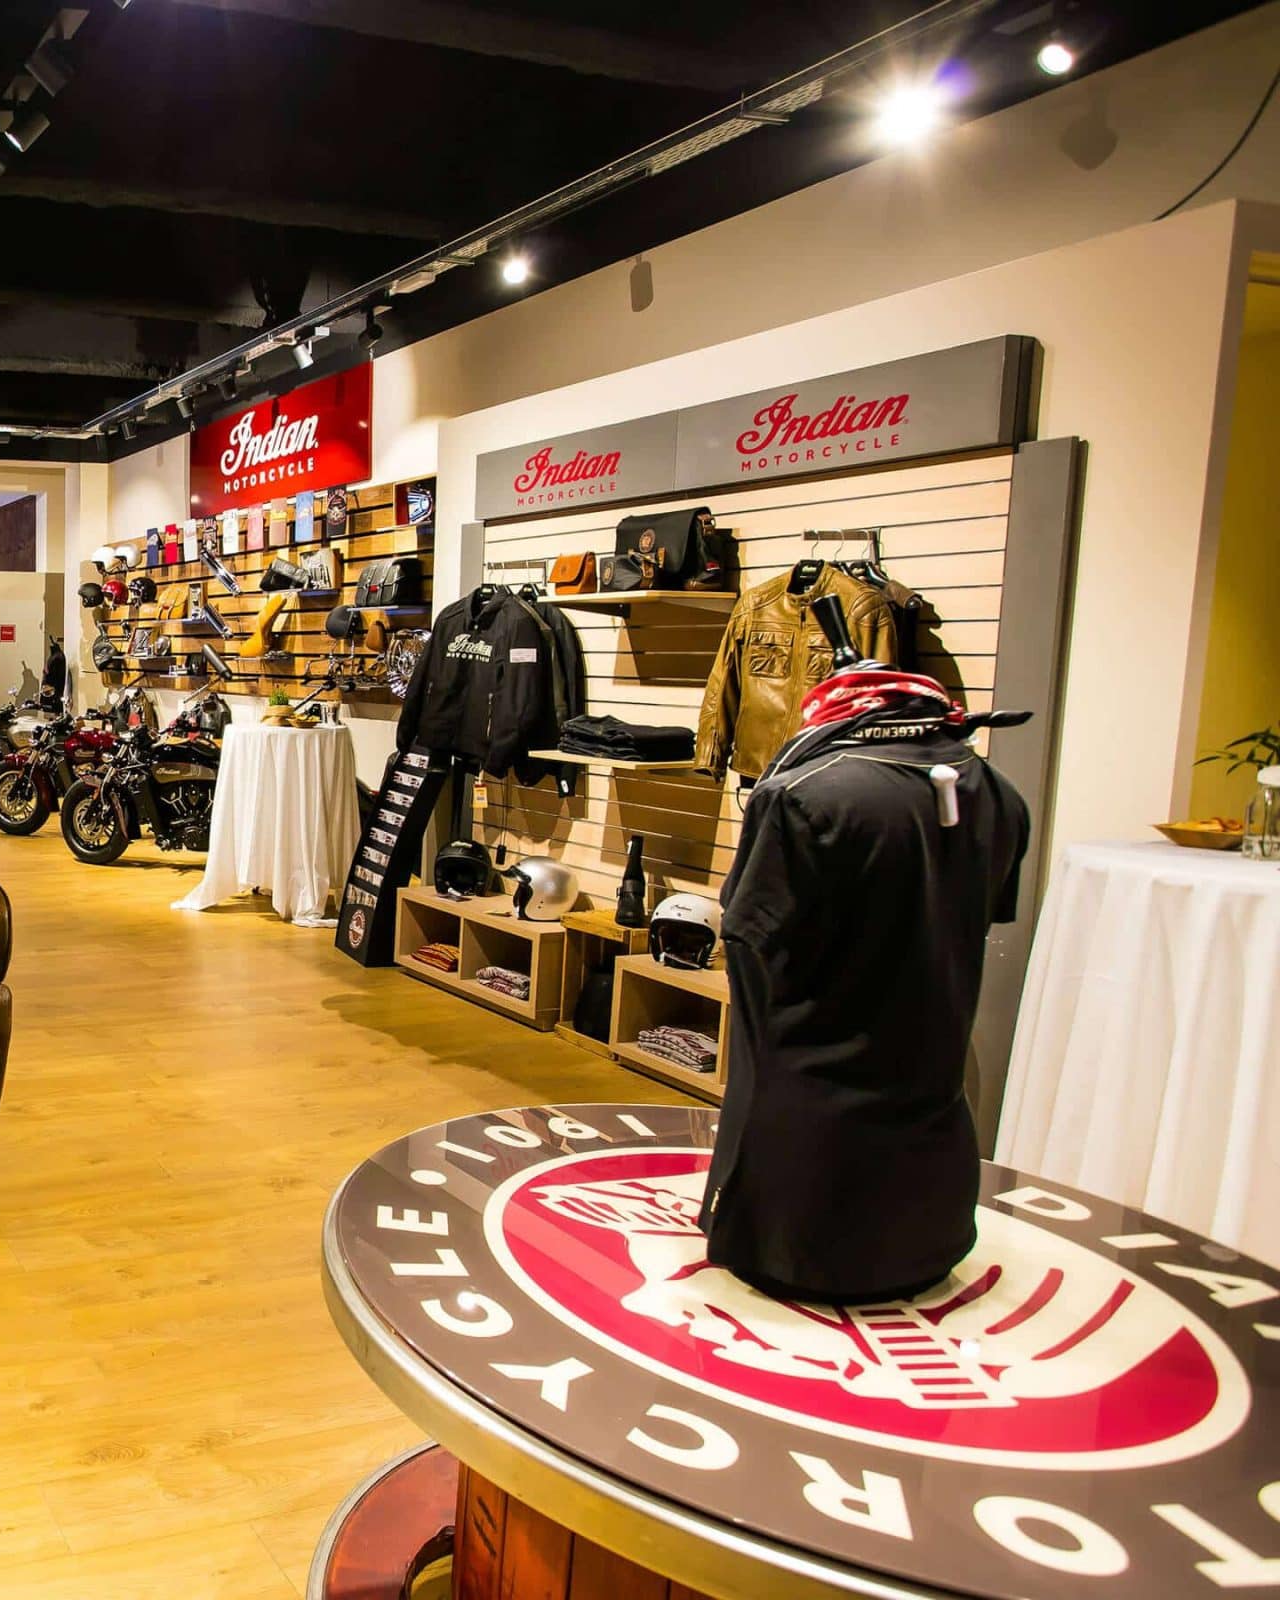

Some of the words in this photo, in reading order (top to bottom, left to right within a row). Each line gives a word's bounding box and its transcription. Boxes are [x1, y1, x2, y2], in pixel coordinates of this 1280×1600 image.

[220, 411, 319, 476] Indian
[736, 394, 910, 455] Indian
[514, 447, 621, 493] Indian
[741, 434, 900, 472] MOTORCYCLE
[224, 457, 314, 494] MOTORCYCLE
[518, 482, 616, 506] MOTORCYCLE
